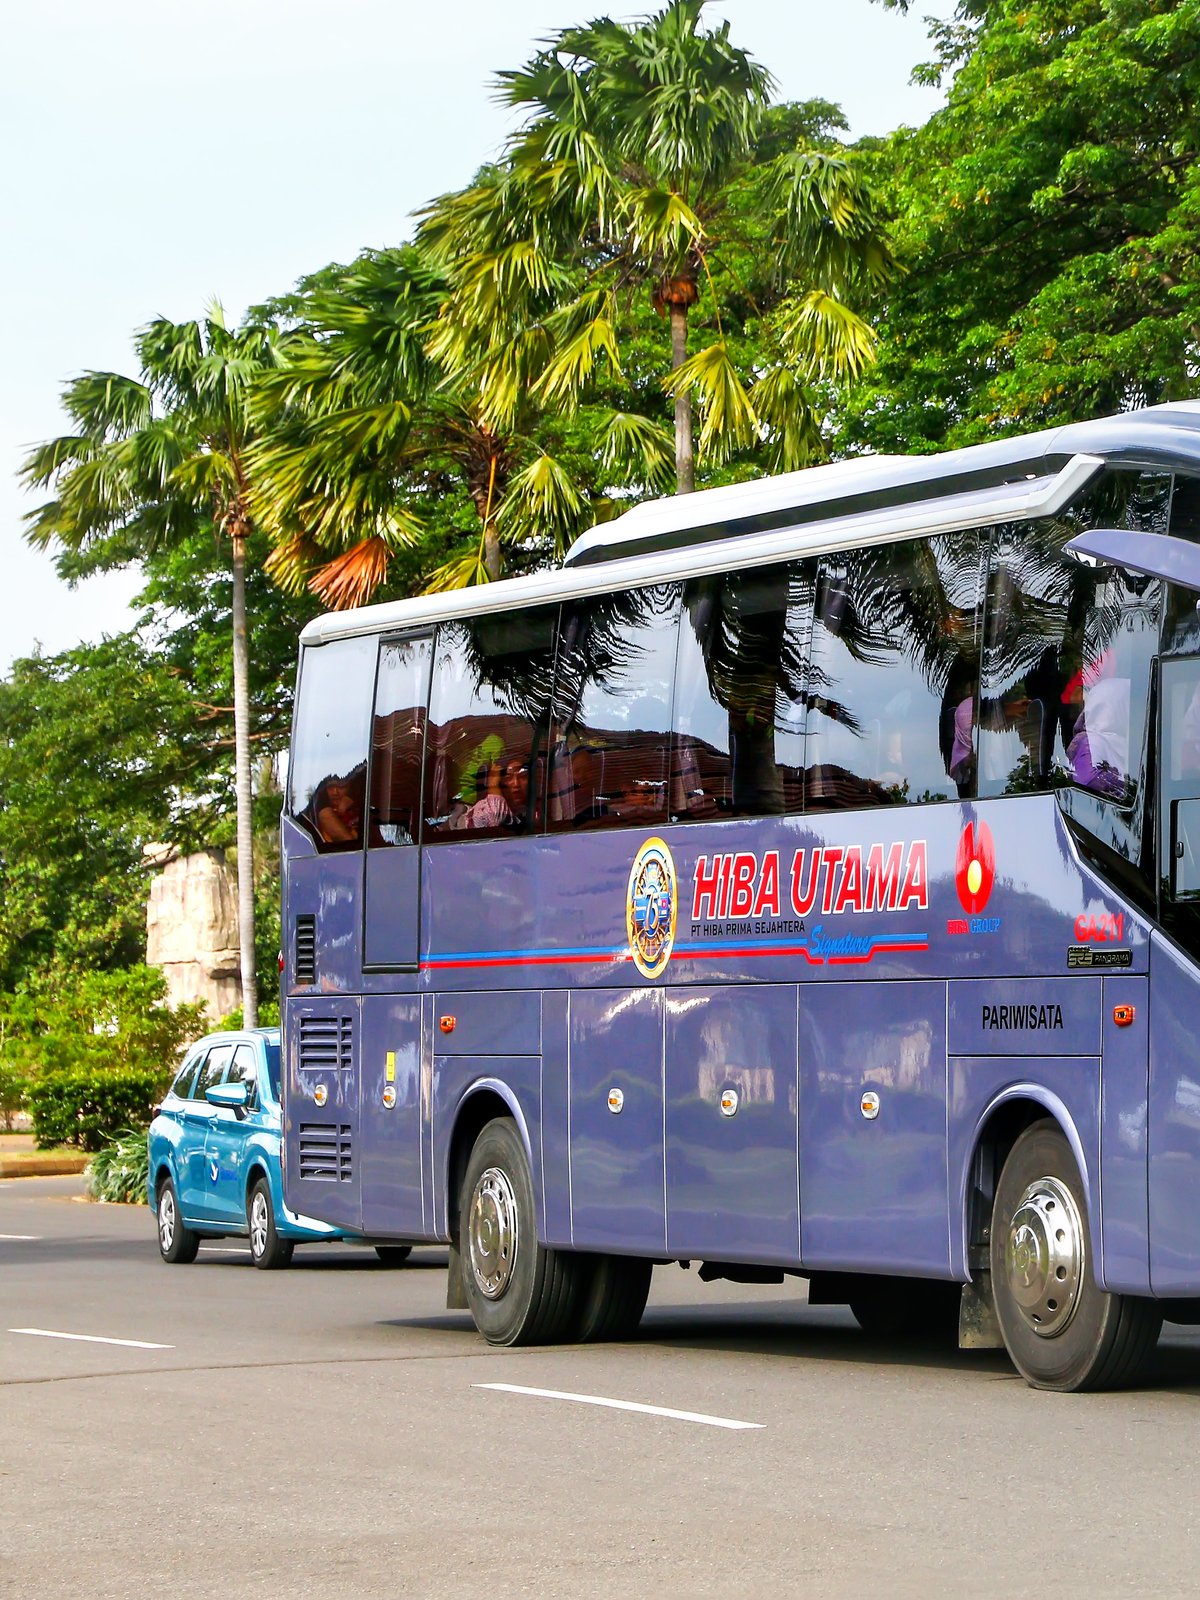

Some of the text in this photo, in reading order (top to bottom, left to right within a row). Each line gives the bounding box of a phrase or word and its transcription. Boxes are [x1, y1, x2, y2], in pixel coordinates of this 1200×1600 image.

[691, 839, 929, 921] HIBA UTAMA
[691, 920, 805, 937] PT HIBA PRIMA SEJAHTERA
[971, 918, 1001, 933] GROUP
[1074, 912, 1124, 942] GA211
[809, 925, 873, 966] Signature
[982, 1005, 1064, 1030] PARIWISATA
